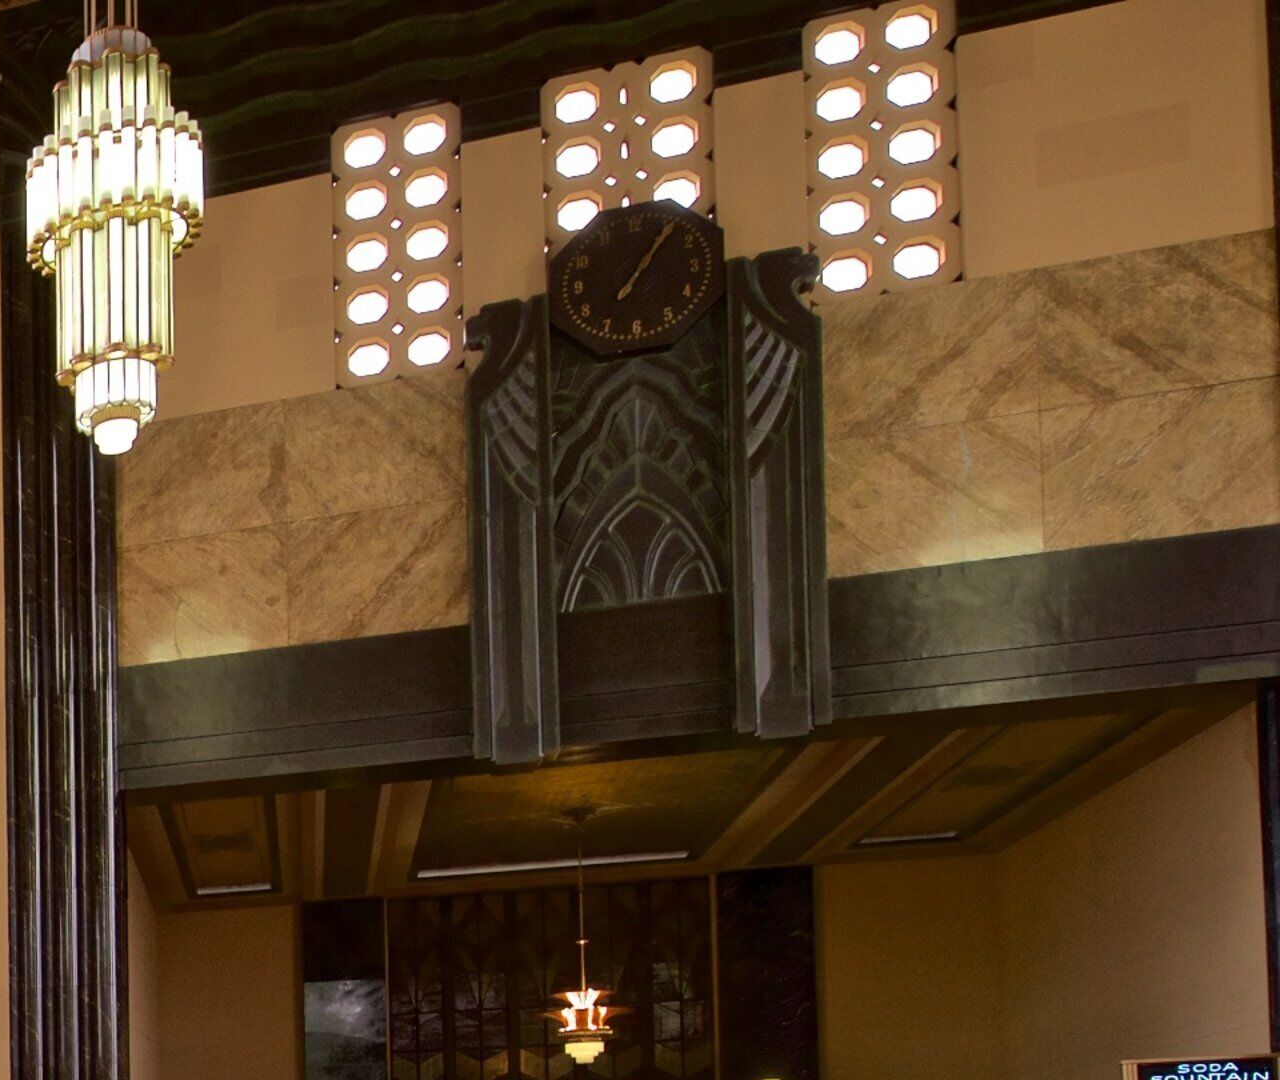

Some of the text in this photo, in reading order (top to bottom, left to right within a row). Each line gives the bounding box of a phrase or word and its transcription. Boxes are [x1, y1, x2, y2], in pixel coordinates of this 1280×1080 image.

[685, 235, 693, 248] 2
[576, 256, 588, 269] 10
[691, 259, 699, 272] 3
[574, 281, 583, 294] 9
[683, 284, 691, 297] 4
[581, 304, 590, 317] 8
[664, 307, 673, 321] 5
[603, 319, 612, 333] 7
[632, 320, 641, 334] 6
[1177, 1062, 1238, 1074] SODA
